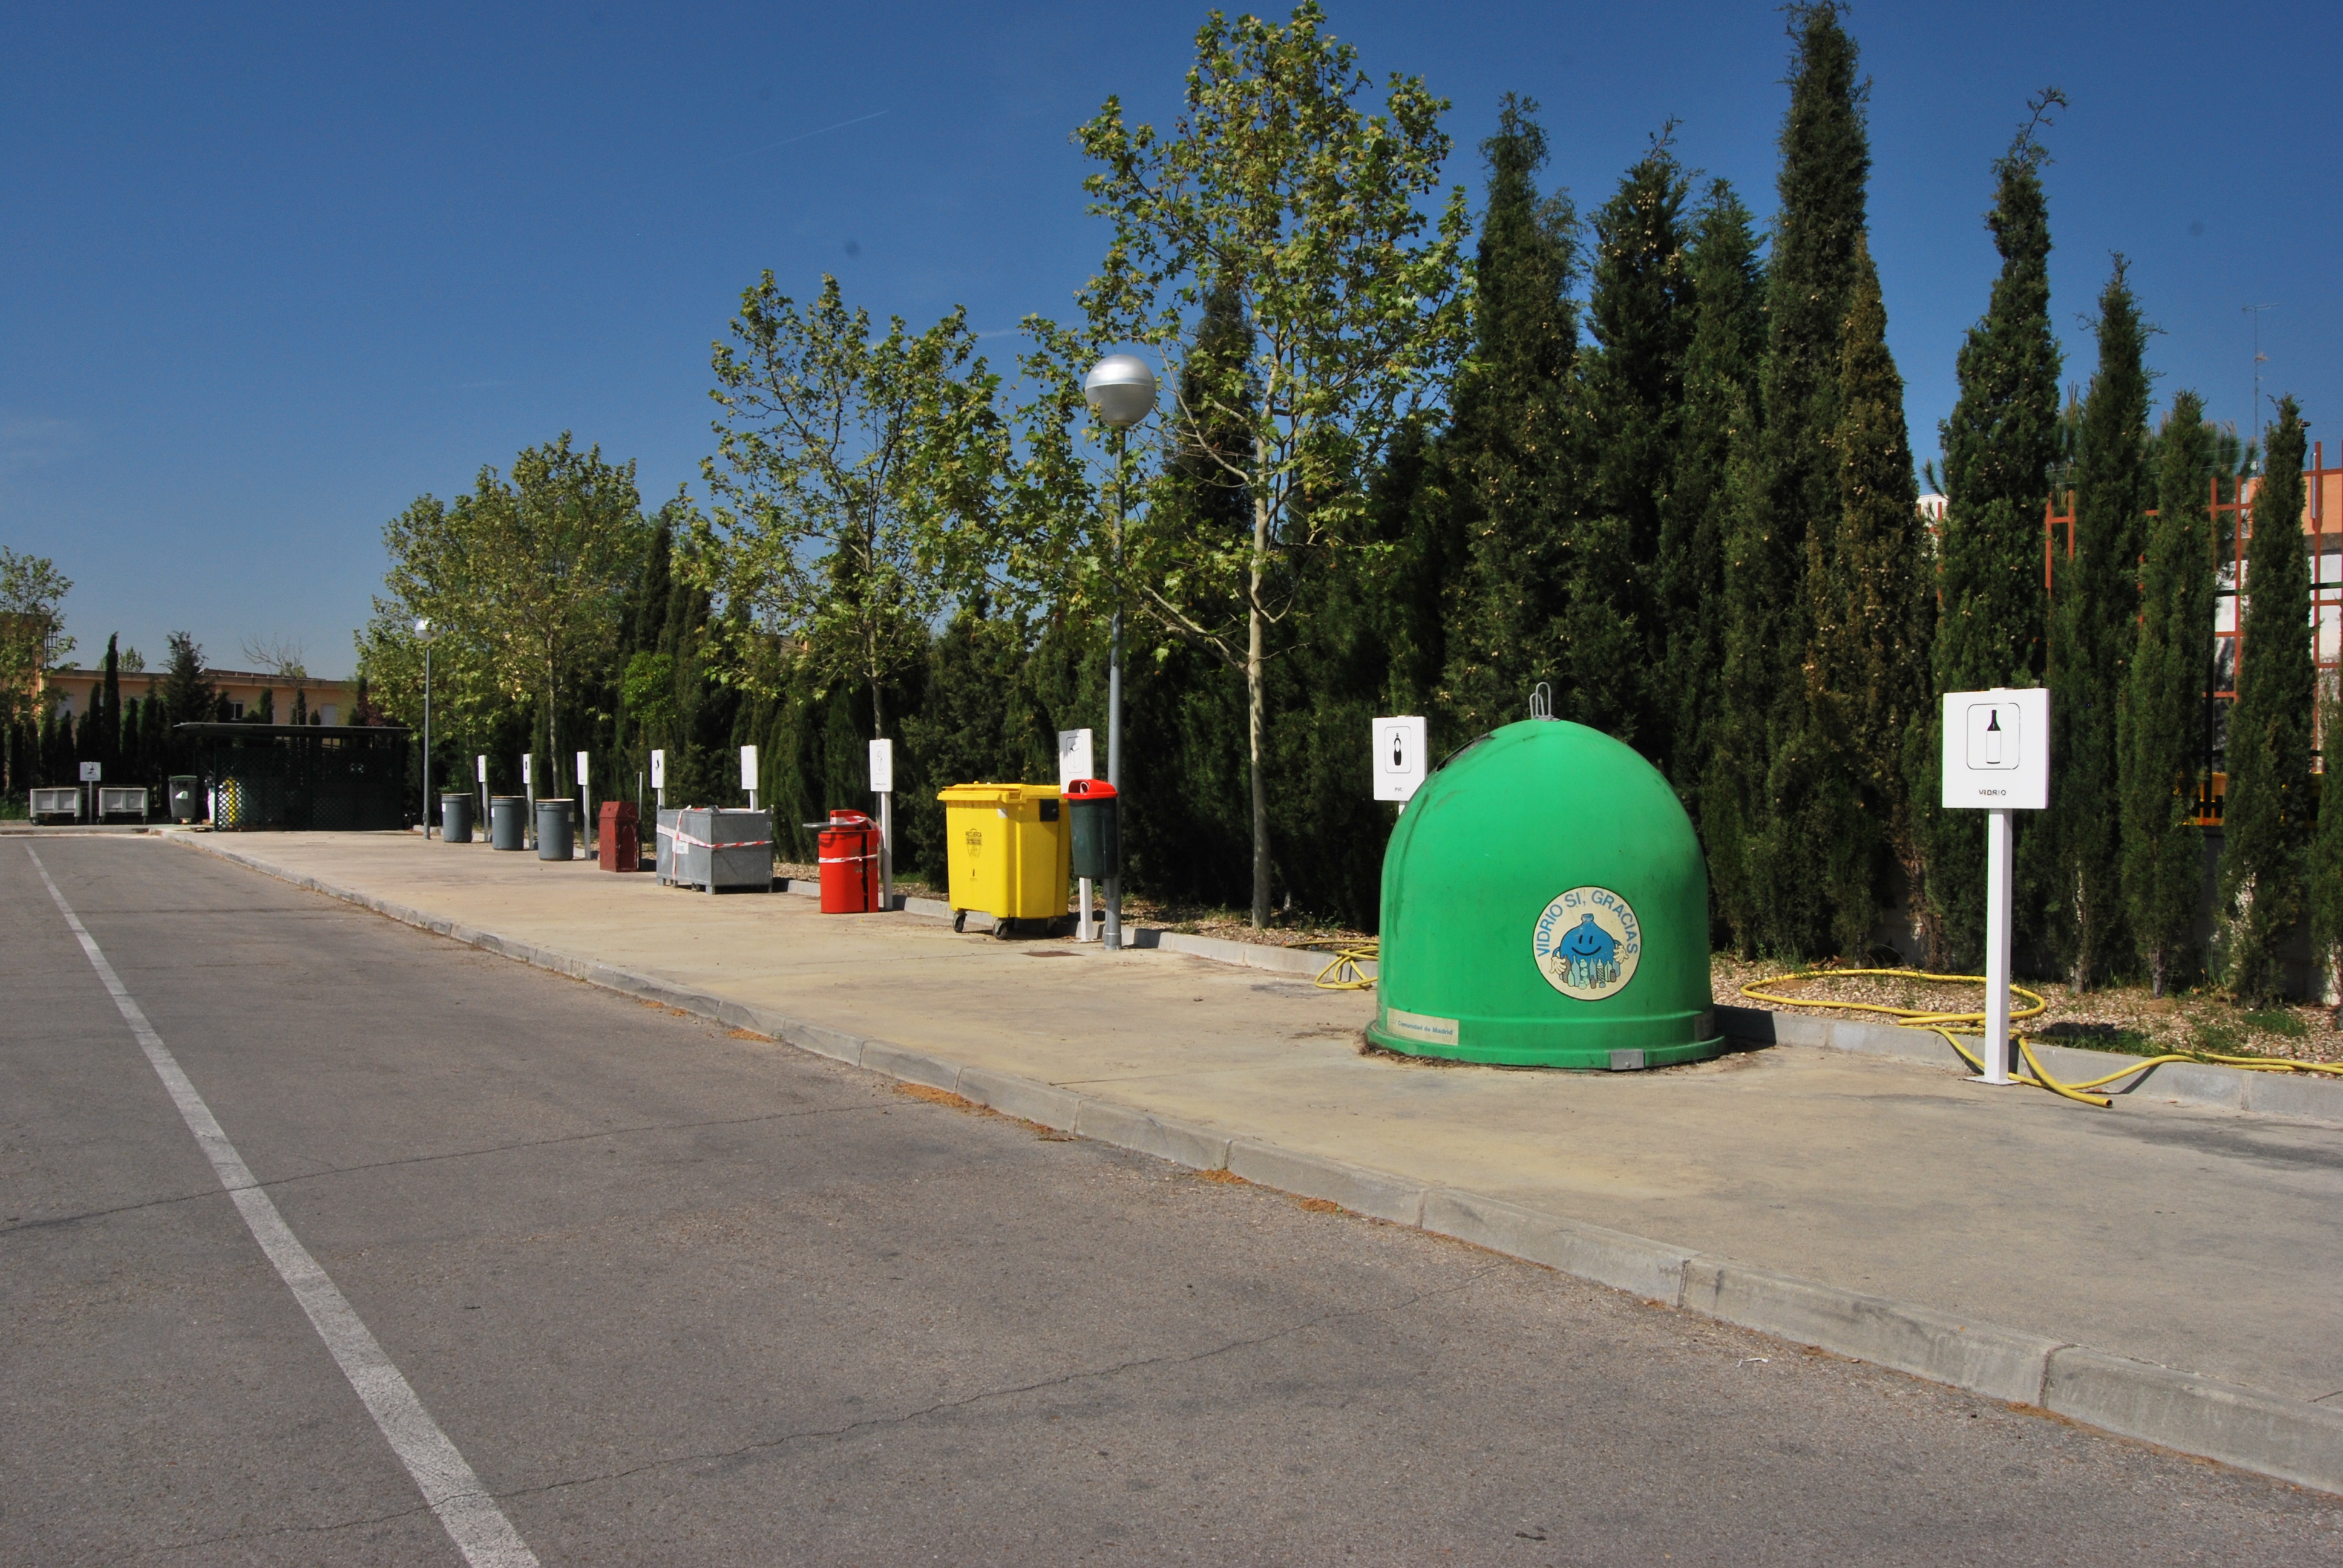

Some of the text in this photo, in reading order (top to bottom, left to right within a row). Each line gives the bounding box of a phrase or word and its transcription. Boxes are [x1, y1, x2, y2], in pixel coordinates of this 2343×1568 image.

[1536, 904, 1563, 957] VIDRIO
[1591, 890, 1638, 955] GRACIAS
[1398, 1021, 1423, 1030] Comunidad
